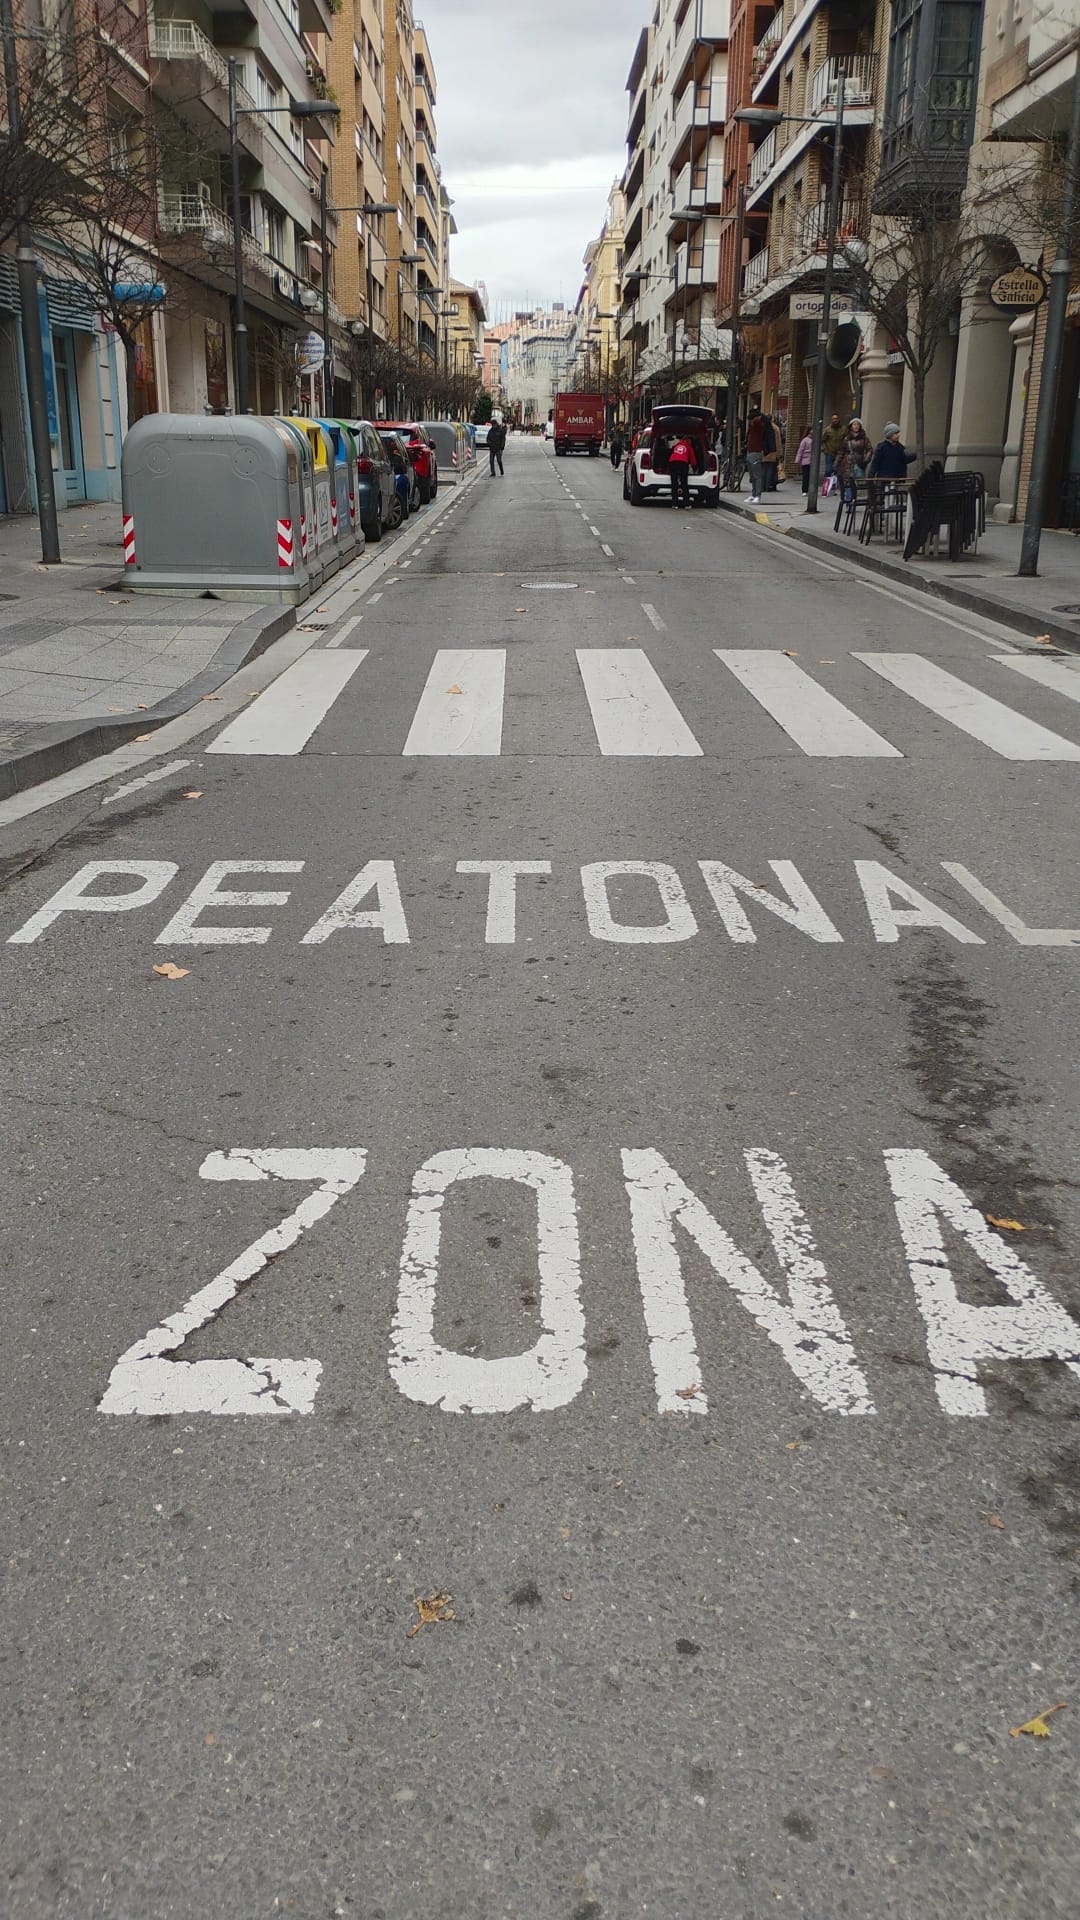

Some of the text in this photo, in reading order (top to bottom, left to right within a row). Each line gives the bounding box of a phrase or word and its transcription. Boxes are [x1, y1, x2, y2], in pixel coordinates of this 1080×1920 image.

[998, 279, 1039, 290] Estrella
[998, 291, 1035, 303] Galicia
[796, 301, 847, 312] ortopdia
[566, 416, 593, 424] AMBAR
[6, 859, 1080, 947] PEATONAL
[96, 1146, 1080, 1418] ZONA
